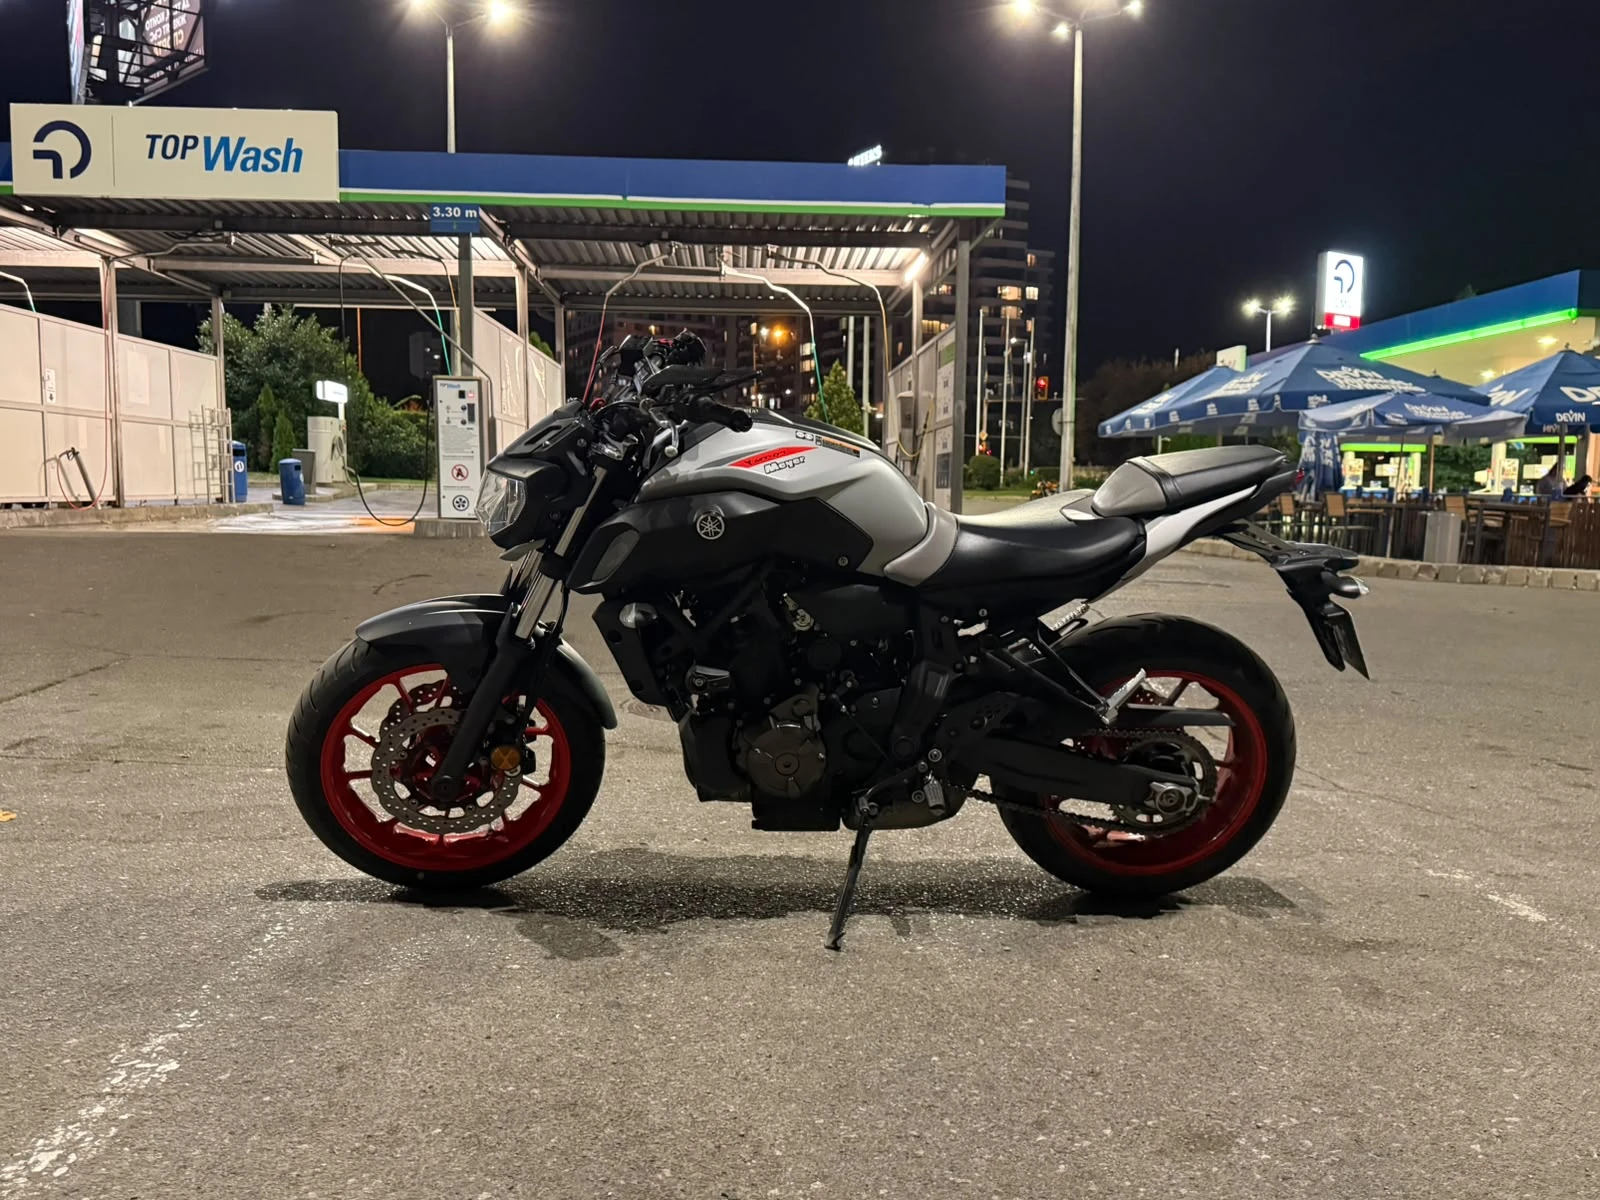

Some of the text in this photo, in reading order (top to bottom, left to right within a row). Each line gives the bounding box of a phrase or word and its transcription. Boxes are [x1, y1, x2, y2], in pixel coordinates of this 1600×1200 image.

[146, 134, 304, 173] TOP Wash
[432, 206, 477, 218] 3.30 m
[1555, 409, 1586, 423] DEVIN
